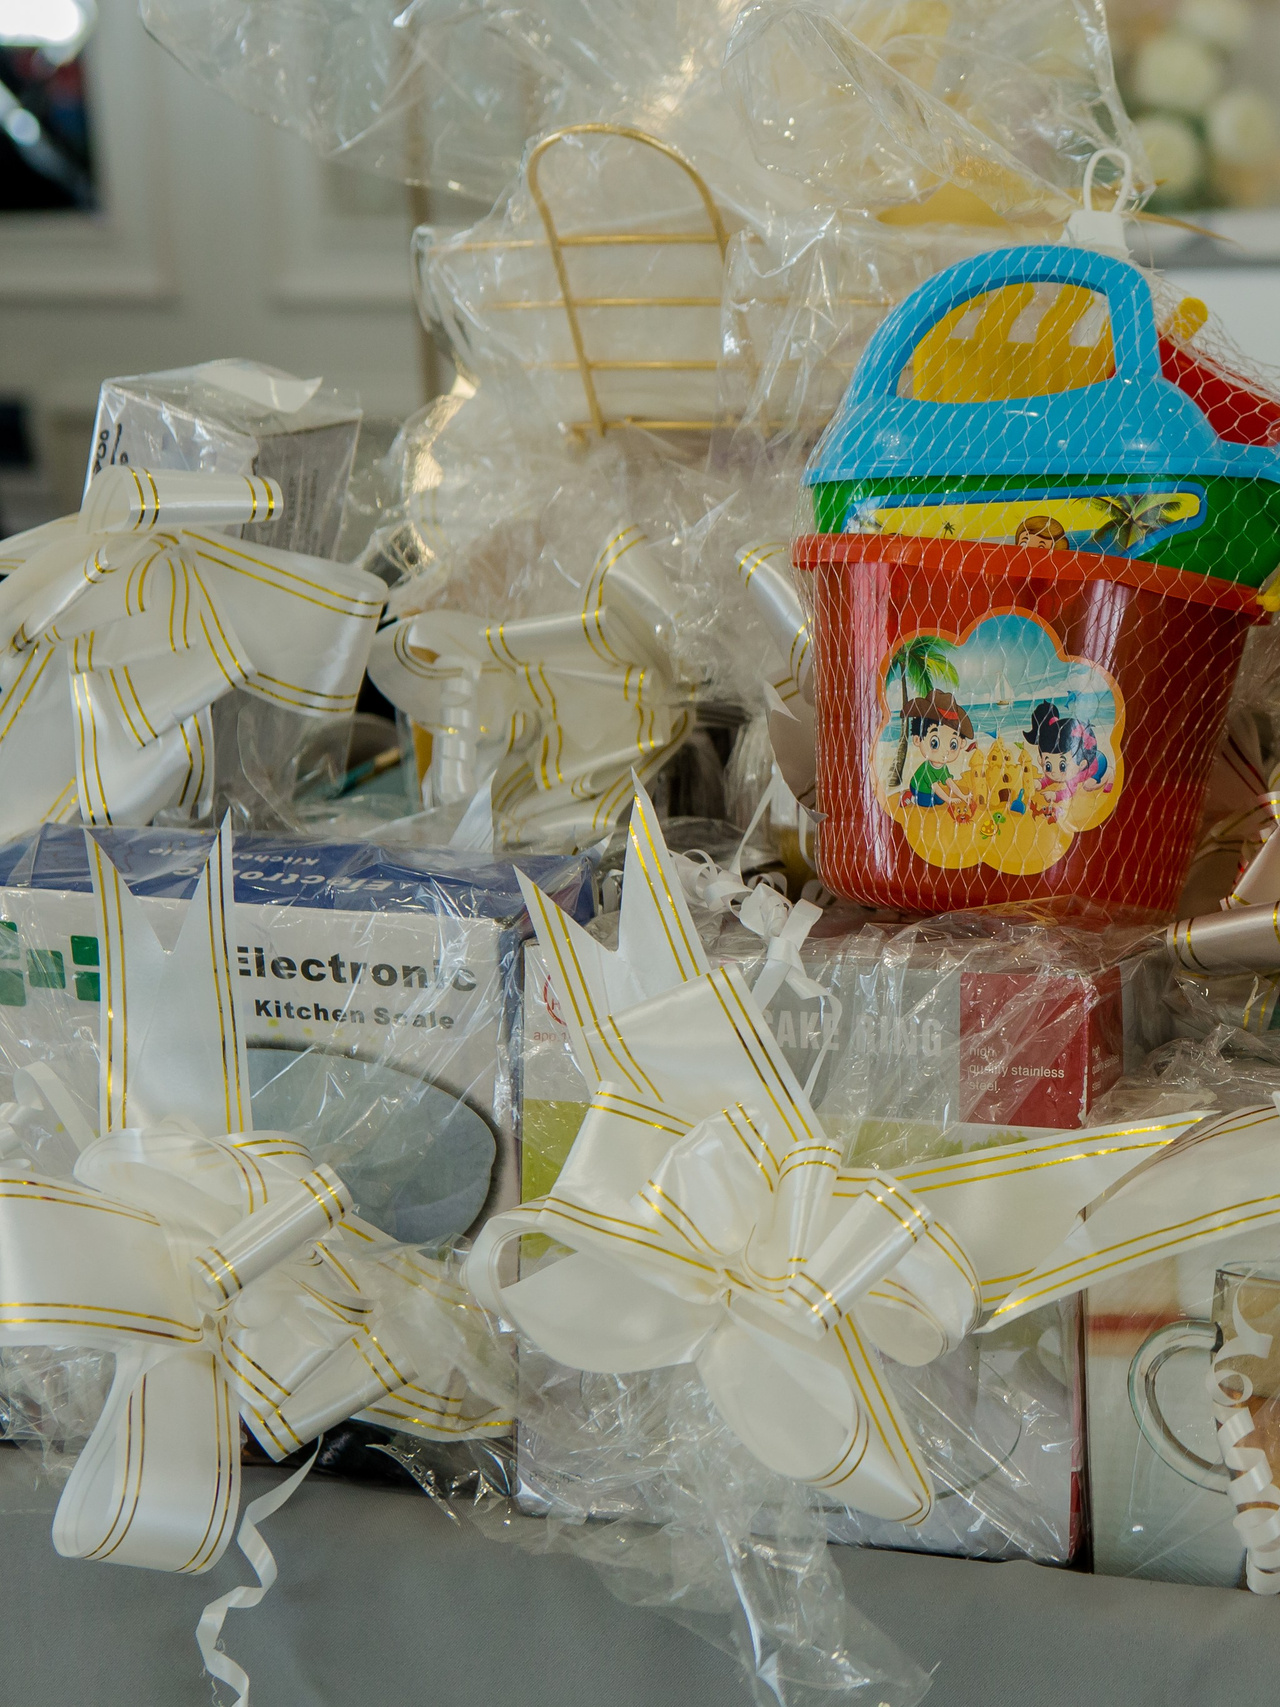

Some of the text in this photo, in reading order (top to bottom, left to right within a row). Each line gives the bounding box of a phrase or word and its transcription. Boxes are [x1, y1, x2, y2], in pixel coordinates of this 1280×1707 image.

[232, 853, 320, 867] Kitche
[237, 945, 478, 992] Electronic
[255, 999, 455, 1030] Kitchen Scale
[855, 1014, 943, 1057] RING
[969, 1045, 996, 1058] high
[969, 1064, 1065, 1079] quality stainless
